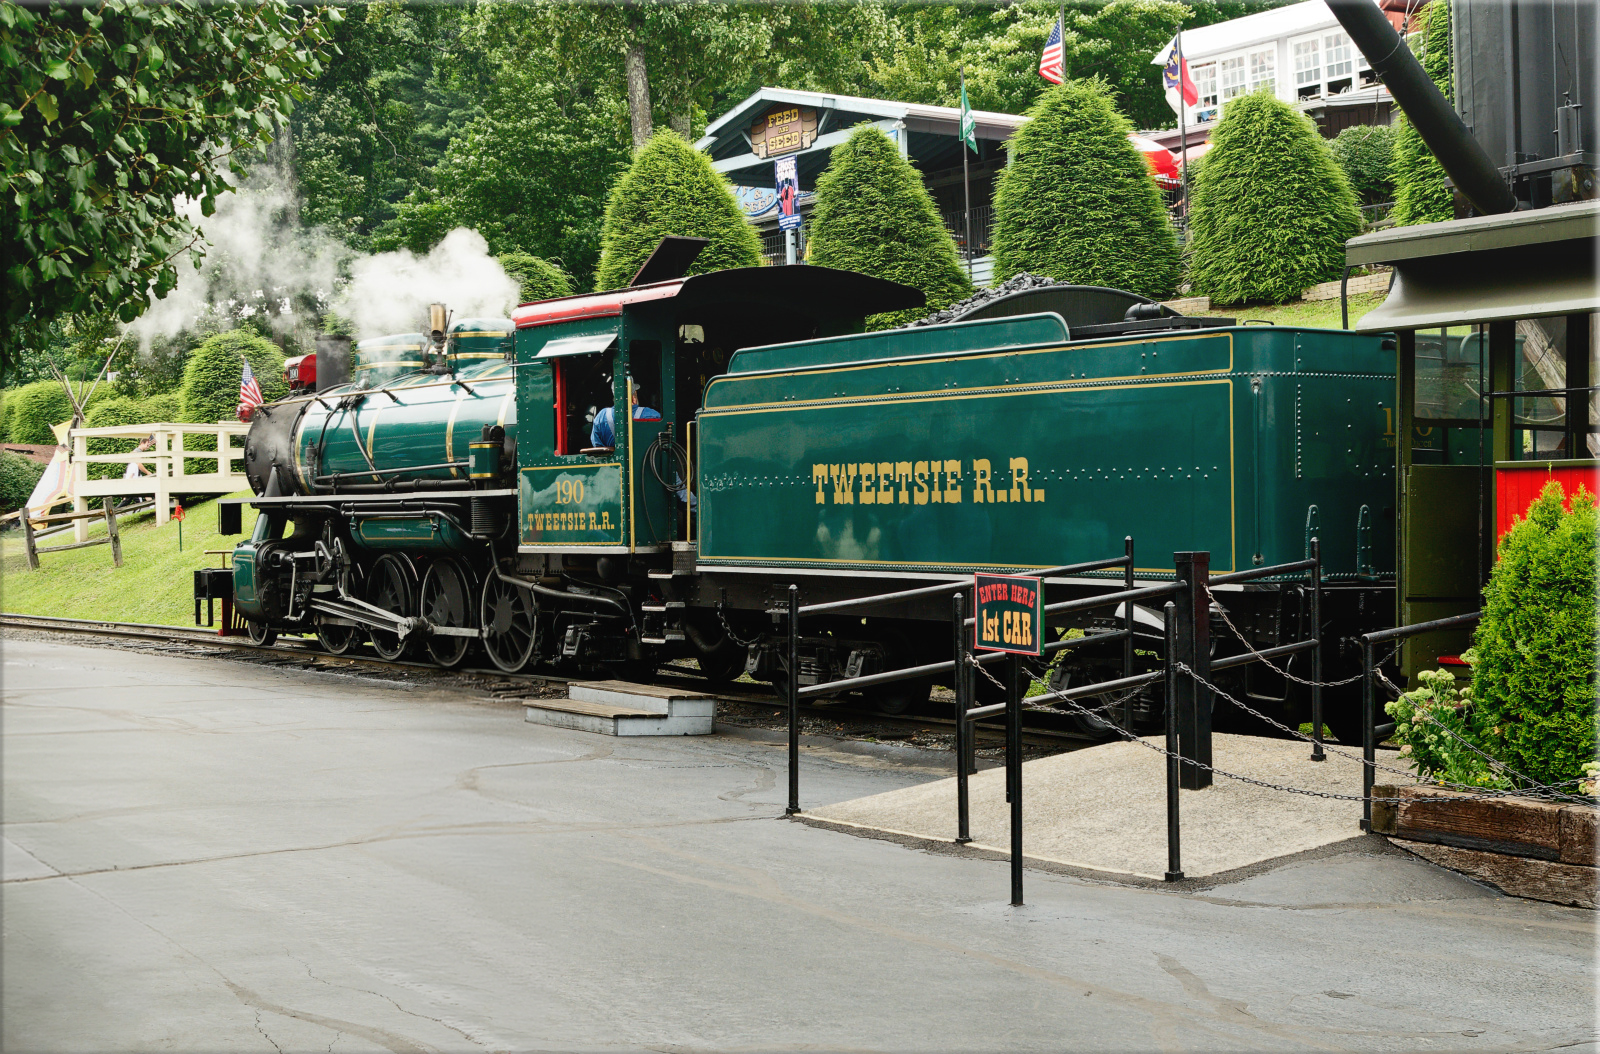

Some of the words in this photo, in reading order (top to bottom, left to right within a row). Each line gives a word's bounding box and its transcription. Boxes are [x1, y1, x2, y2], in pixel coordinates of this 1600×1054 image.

[768, 108, 799, 128] FEED
[769, 131, 799, 151] SEED
[743, 193, 774, 212] SEED
[1383, 408, 1433, 436] 10
[555, 480, 584, 504] 190
[812, 459, 962, 505] TWEETSIE
[973, 457, 1045, 503] R.R.
[527, 512, 586, 531] TWEETSIE
[589, 511, 615, 530] R.R.
[979, 583, 1008, 604] ENTER
[1011, 584, 1036, 609] HERE
[982, 608, 1000, 643] 1st
[1003, 610, 1032, 646] CAR
